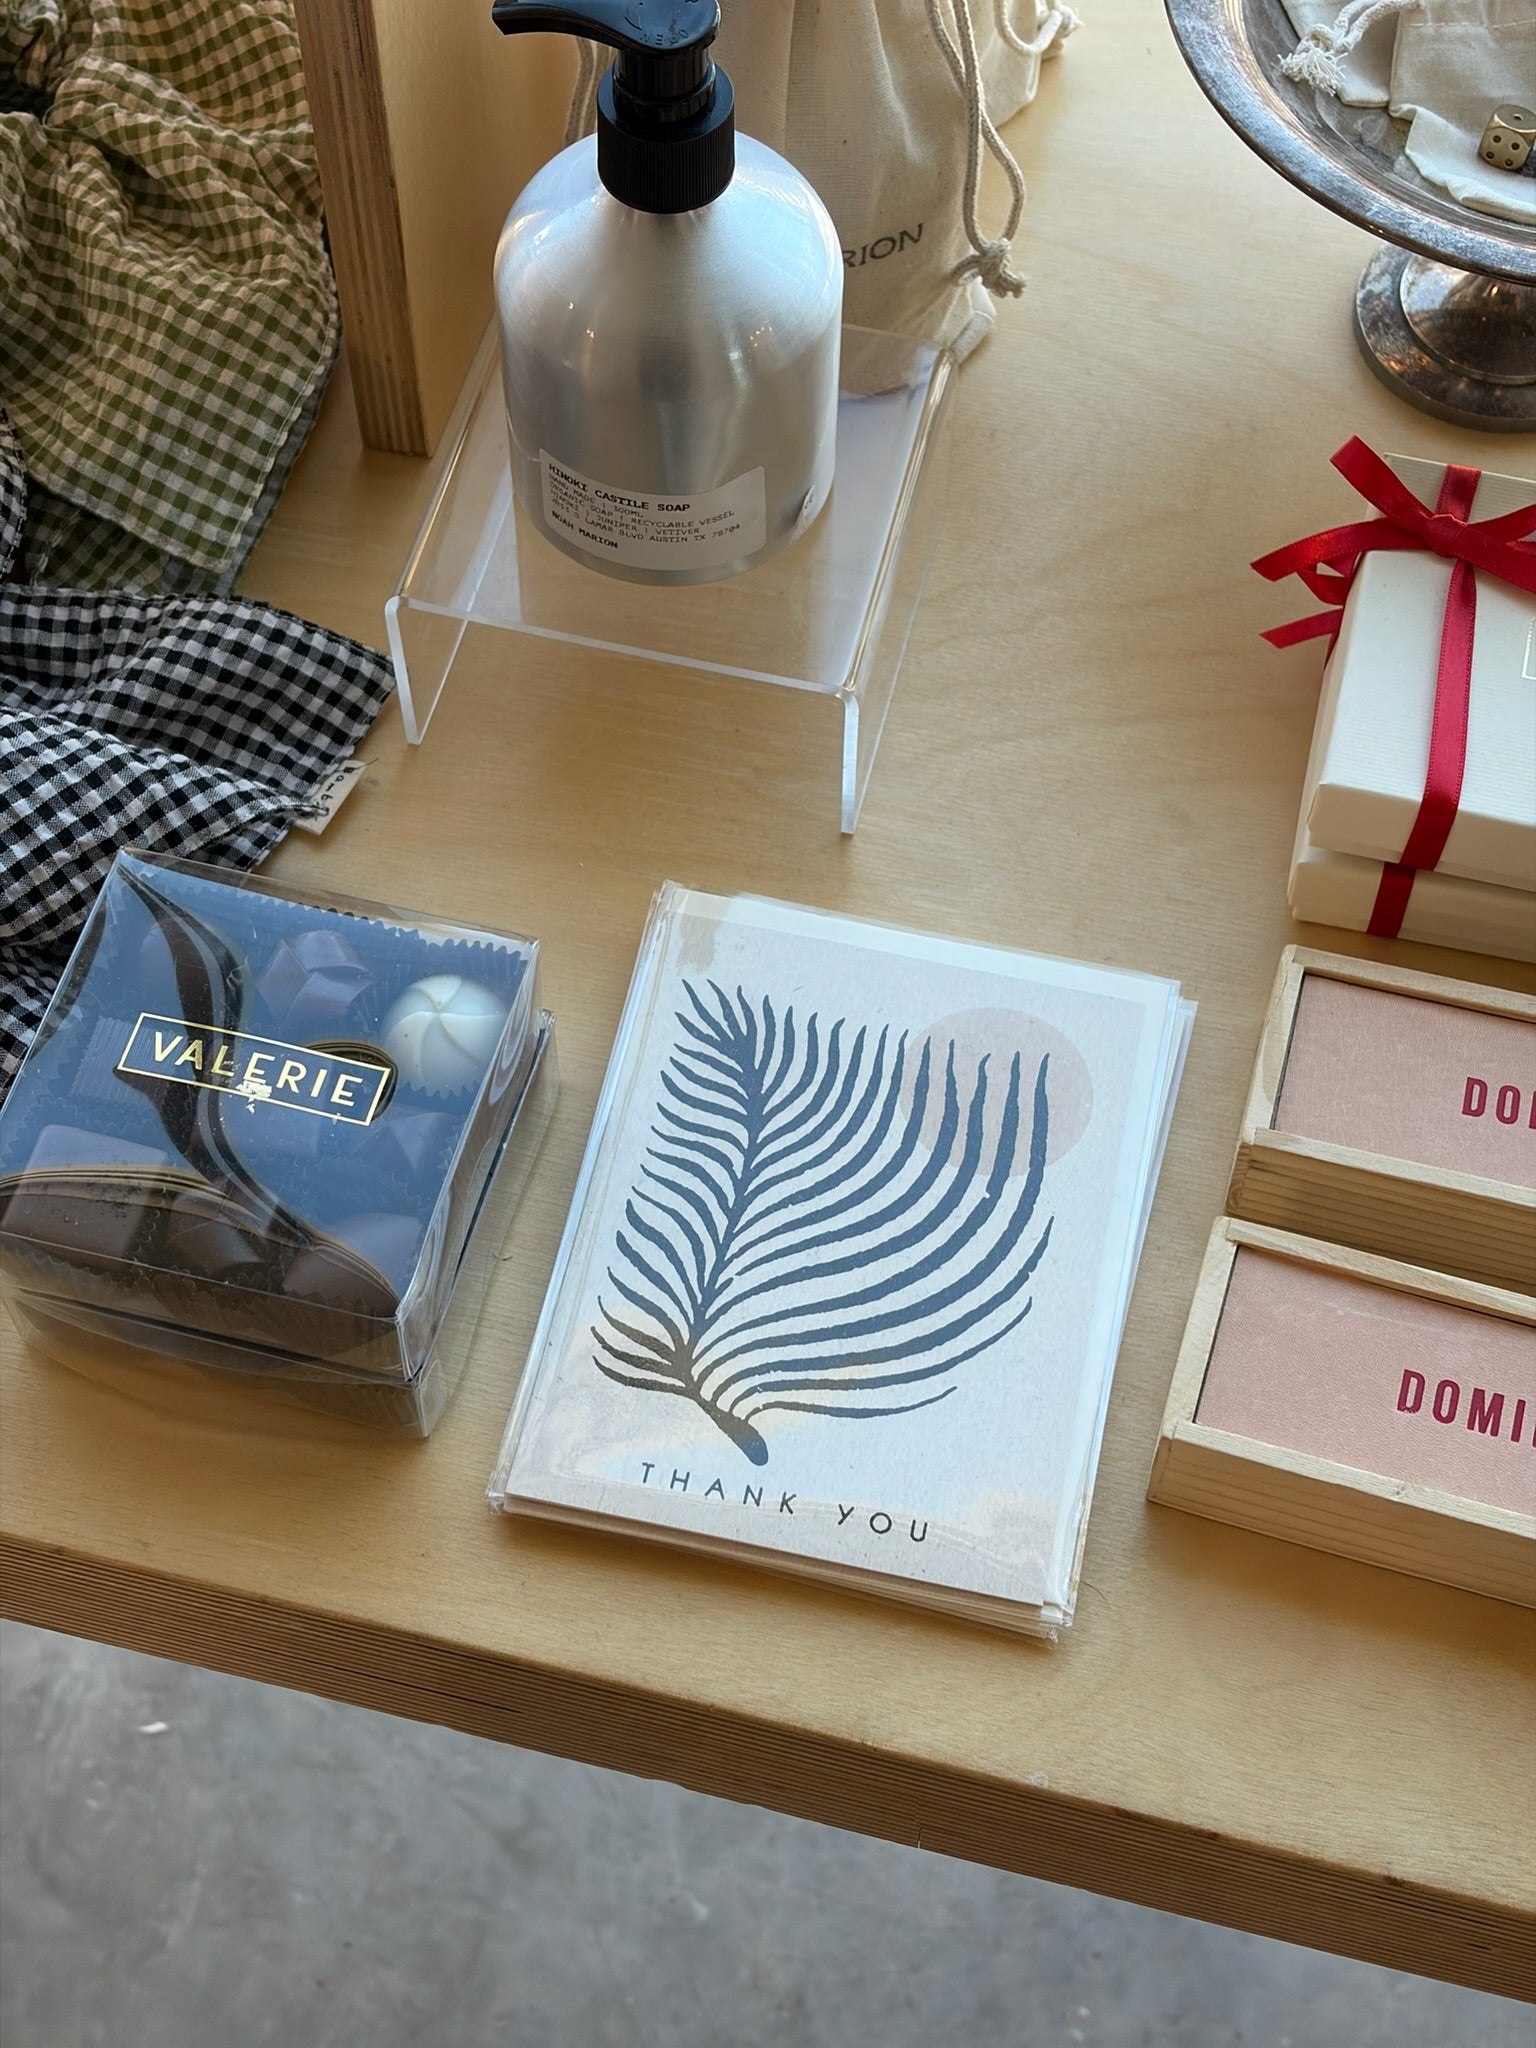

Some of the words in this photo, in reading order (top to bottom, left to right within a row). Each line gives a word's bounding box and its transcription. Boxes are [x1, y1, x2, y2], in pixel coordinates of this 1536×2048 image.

[842, 222, 925, 268] RION
[548, 463, 588, 493] HINOKI
[594, 489, 650, 510] CASTILE
[657, 503, 691, 512] SOAP
[573, 489, 595, 504] MADE
[551, 510, 575, 530] NOAH
[578, 527, 618, 549] MARION
[584, 517, 614, 532] LAMAR
[619, 529, 644, 541] BLVD
[649, 535, 688, 543] AUSTIN
[711, 523, 741, 538] 78704
[589, 504, 614, 517] SOAP
[630, 517, 694, 528] RECYCLABLE
[699, 510, 735, 526] VESSEL
[597, 514, 638, 532] JUNIPER
[655, 528, 700, 536] VETIVER
[153, 1031, 363, 1106] VALERIE
[1461, 1076, 1536, 1130] DO
[1397, 1369, 1536, 1448] DOMI
[641, 1462, 797, 1515] THANK
[837, 1503, 928, 1542] YOU
